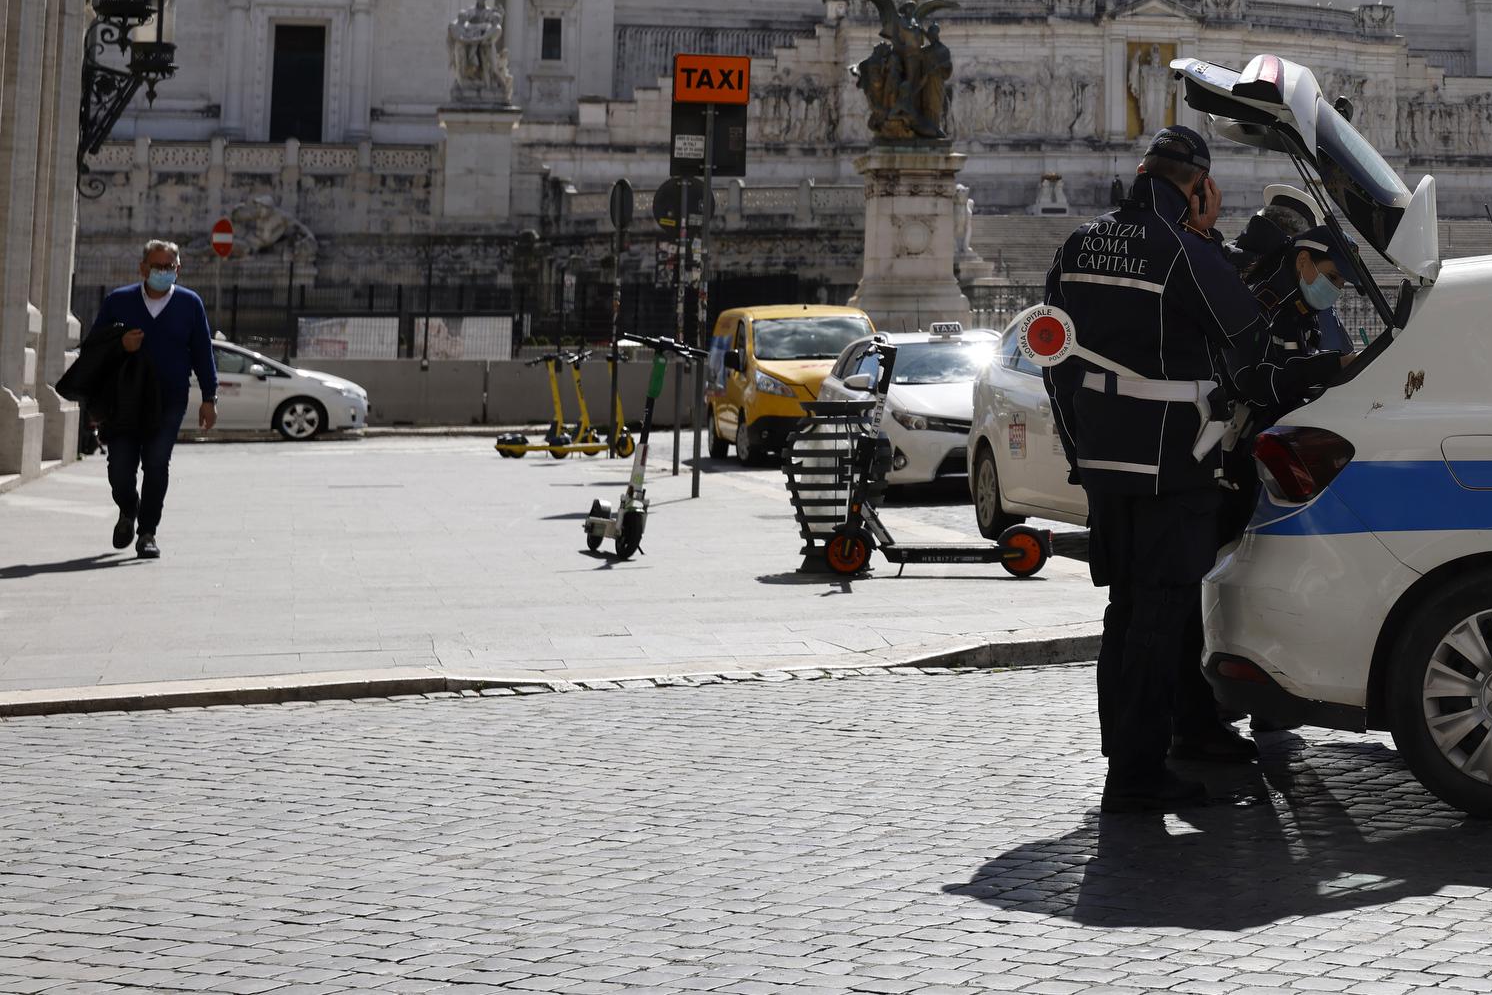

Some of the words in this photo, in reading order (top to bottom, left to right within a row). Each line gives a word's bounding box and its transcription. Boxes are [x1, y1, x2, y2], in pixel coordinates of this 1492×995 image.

[680, 68, 744, 90] TAXI
[1087, 221, 1146, 239] POLIZIA
[1080, 236, 1129, 254] ROMA
[1076, 252, 1149, 275] CAPITALE
[934, 324, 959, 332] TAXI
[1020, 308, 1052, 332] CAPITALE
[1020, 335, 1035, 359] ROMA
[1048, 346, 1069, 361] POLIZIA
[872, 398, 885, 435] HELBIZ
